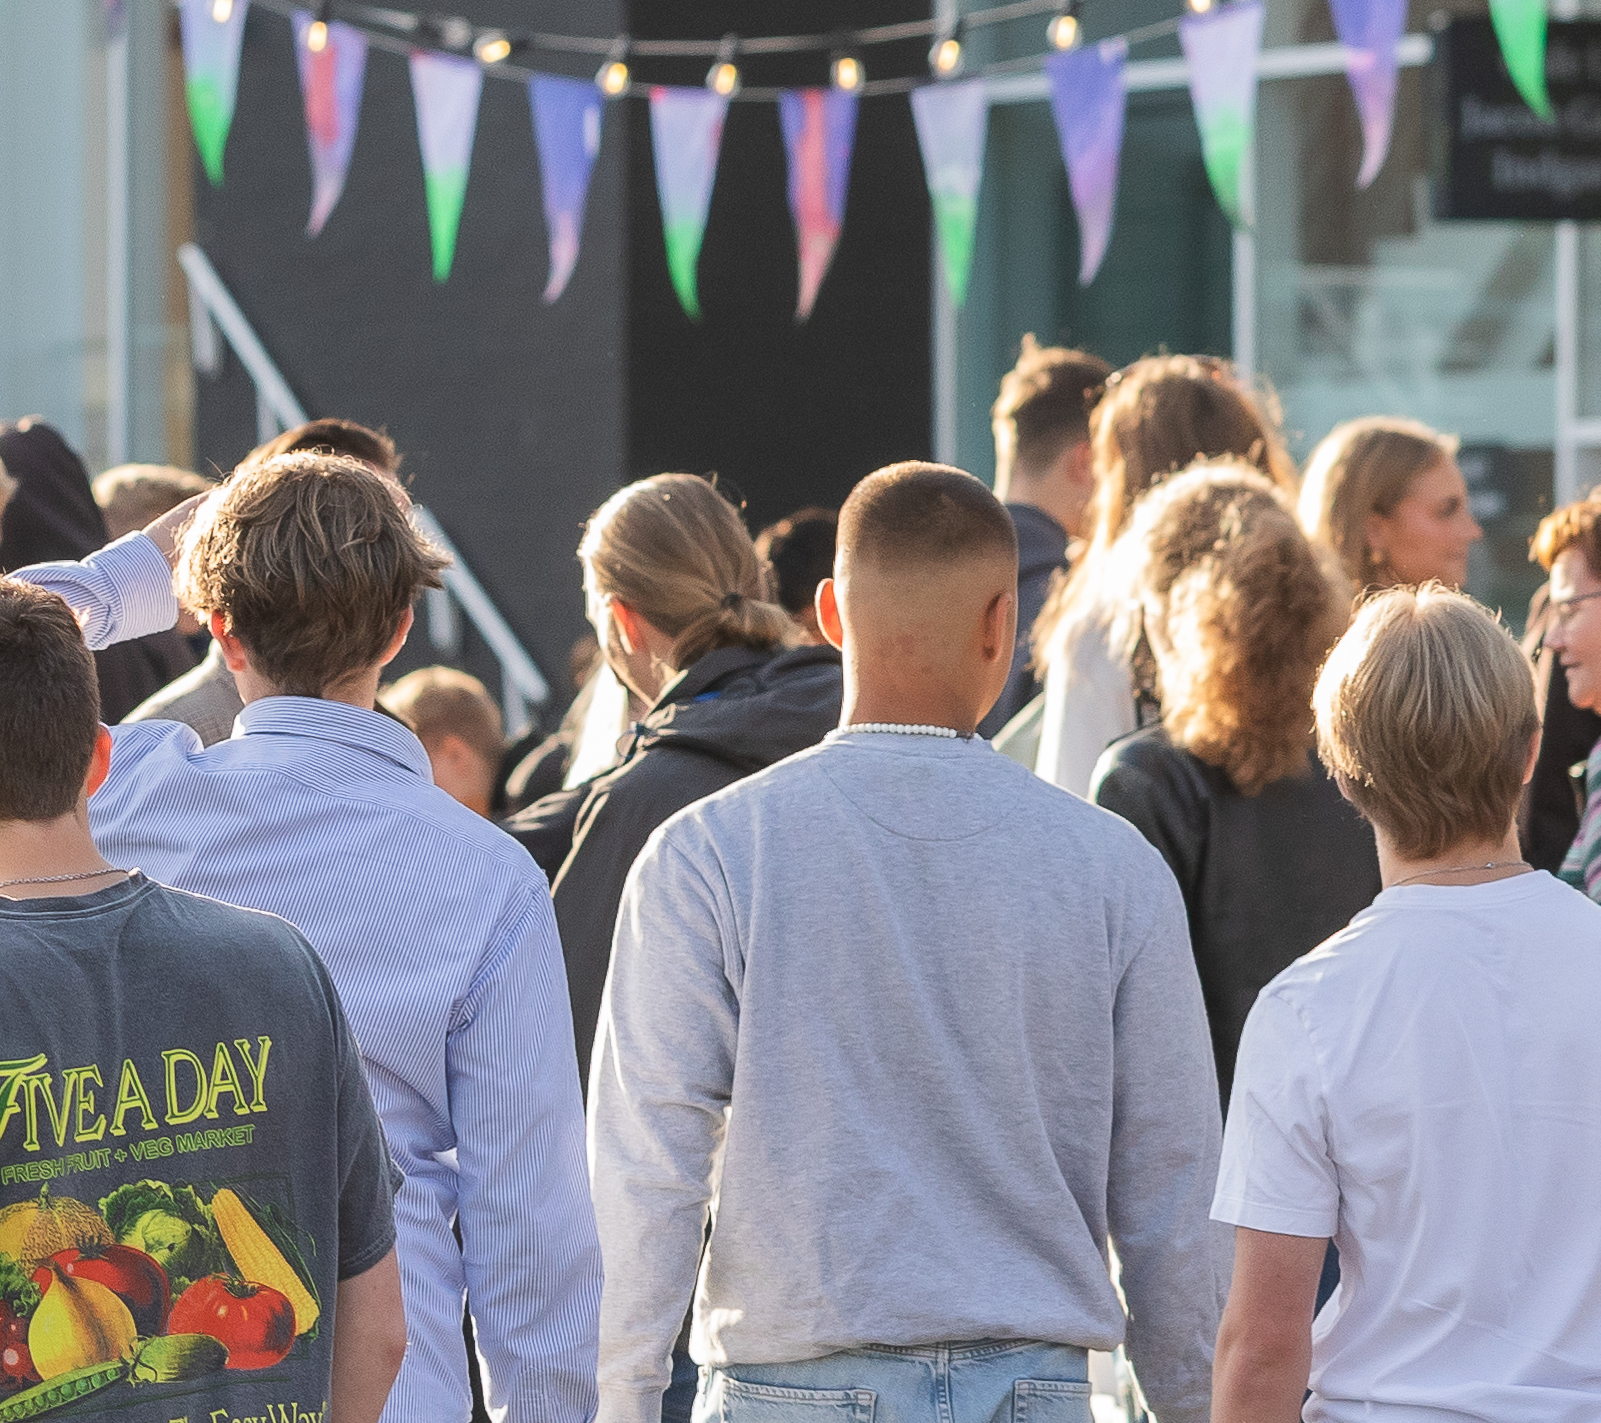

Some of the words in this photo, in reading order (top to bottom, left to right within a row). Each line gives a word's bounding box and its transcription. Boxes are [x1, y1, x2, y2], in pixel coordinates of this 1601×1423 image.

[110, 1058, 159, 1136] A
[161, 1035, 272, 1126] DAY
[1, 1156, 64, 1186] FRESH
[65, 1147, 111, 1178] FRUIT
[129, 1137, 174, 1163] VEG
[177, 1124, 255, 1154] MARKET
